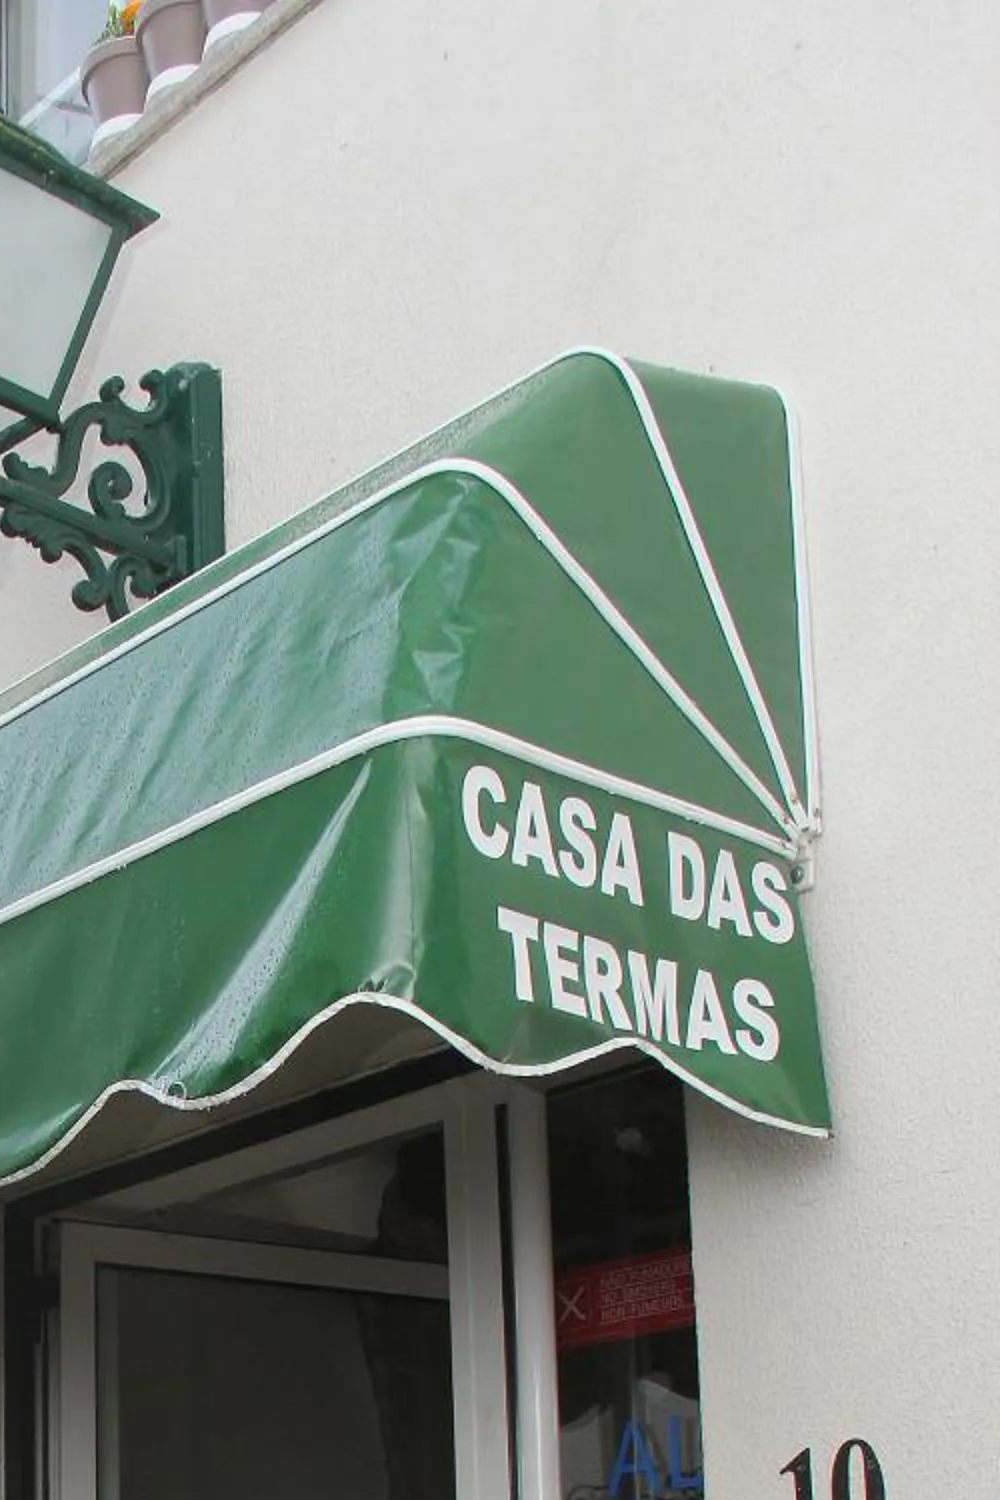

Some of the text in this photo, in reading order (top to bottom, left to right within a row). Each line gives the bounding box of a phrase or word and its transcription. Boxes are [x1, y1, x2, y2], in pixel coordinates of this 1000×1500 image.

[461, 765, 795, 944] CASA DAS
[497, 906, 781, 1062] TERMAS
